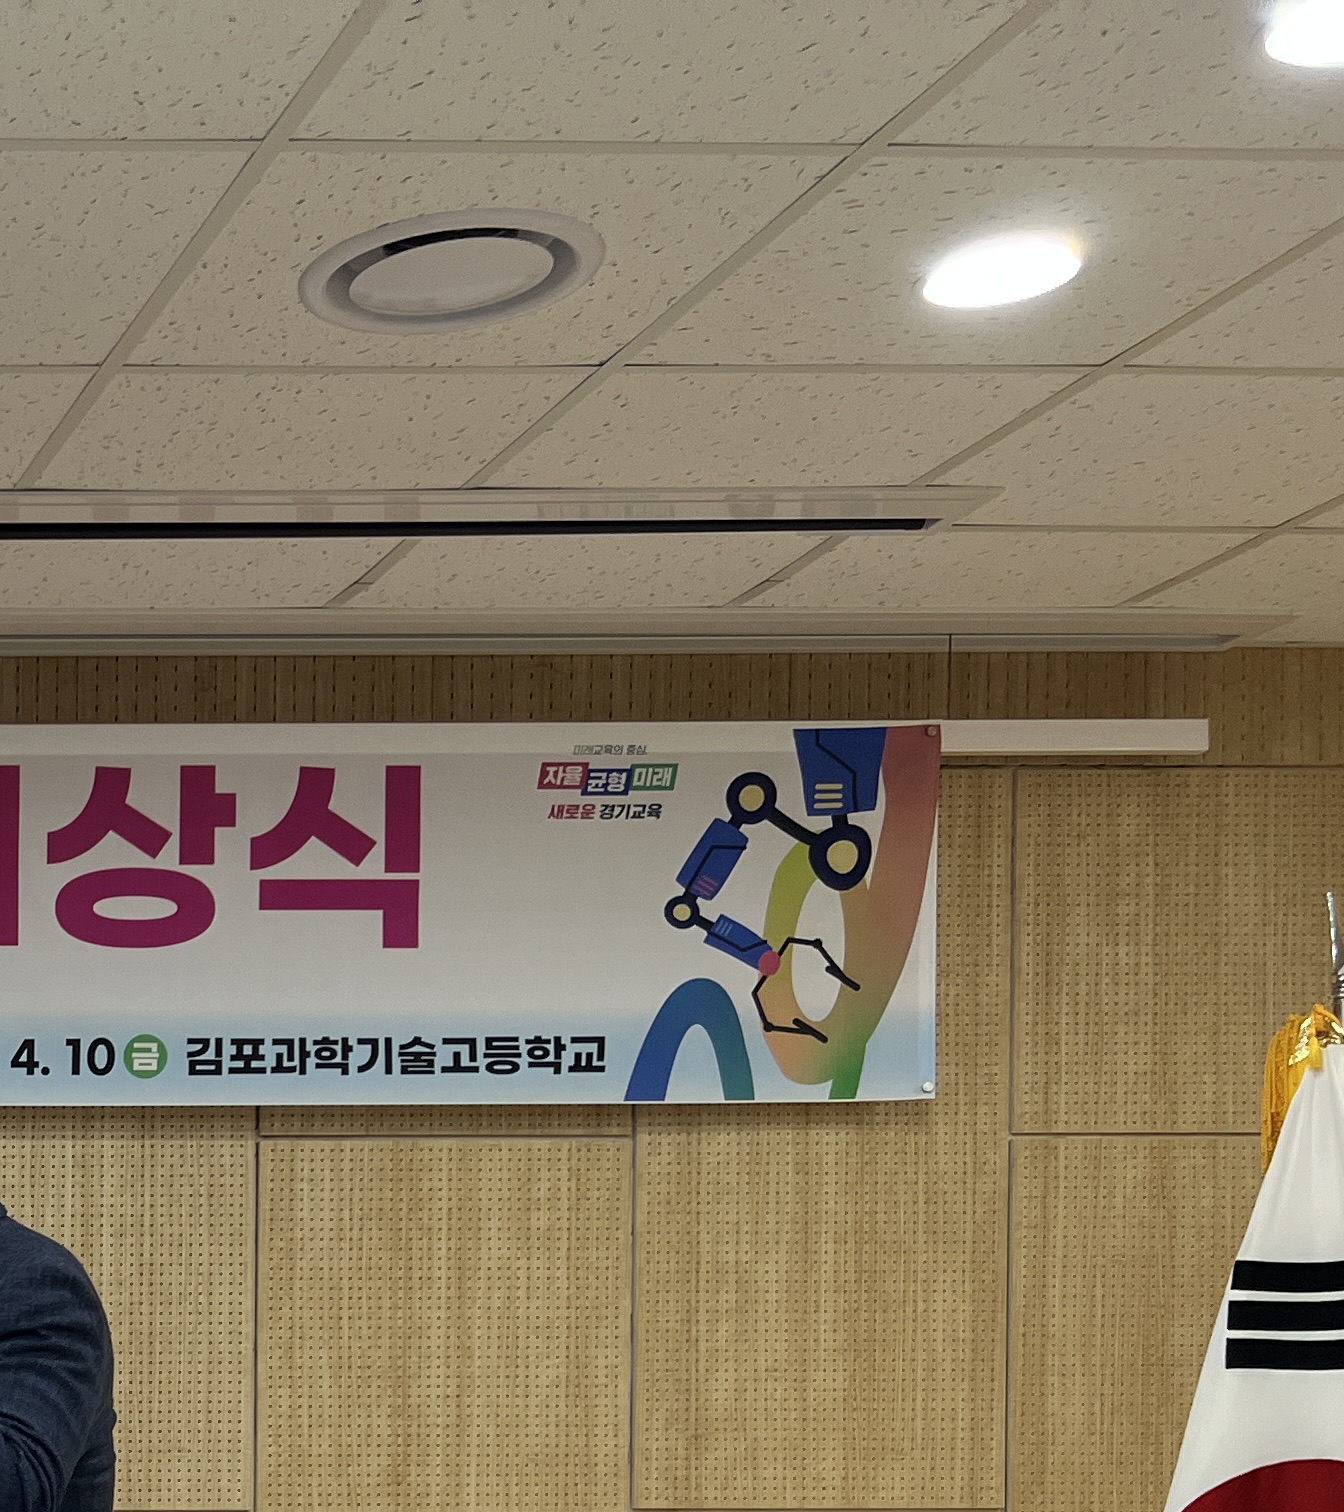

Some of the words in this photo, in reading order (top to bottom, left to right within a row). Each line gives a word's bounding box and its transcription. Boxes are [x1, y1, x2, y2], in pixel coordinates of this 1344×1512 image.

[543, 765, 583, 786] 자율
[587, 771, 627, 793] 균형
[632, 767, 672, 787] 미래
[548, 803, 596, 820] 새로운
[599, 803, 663, 820] 경기교육
[186, 1036, 606, 1076] 김포과학기술고등학교
